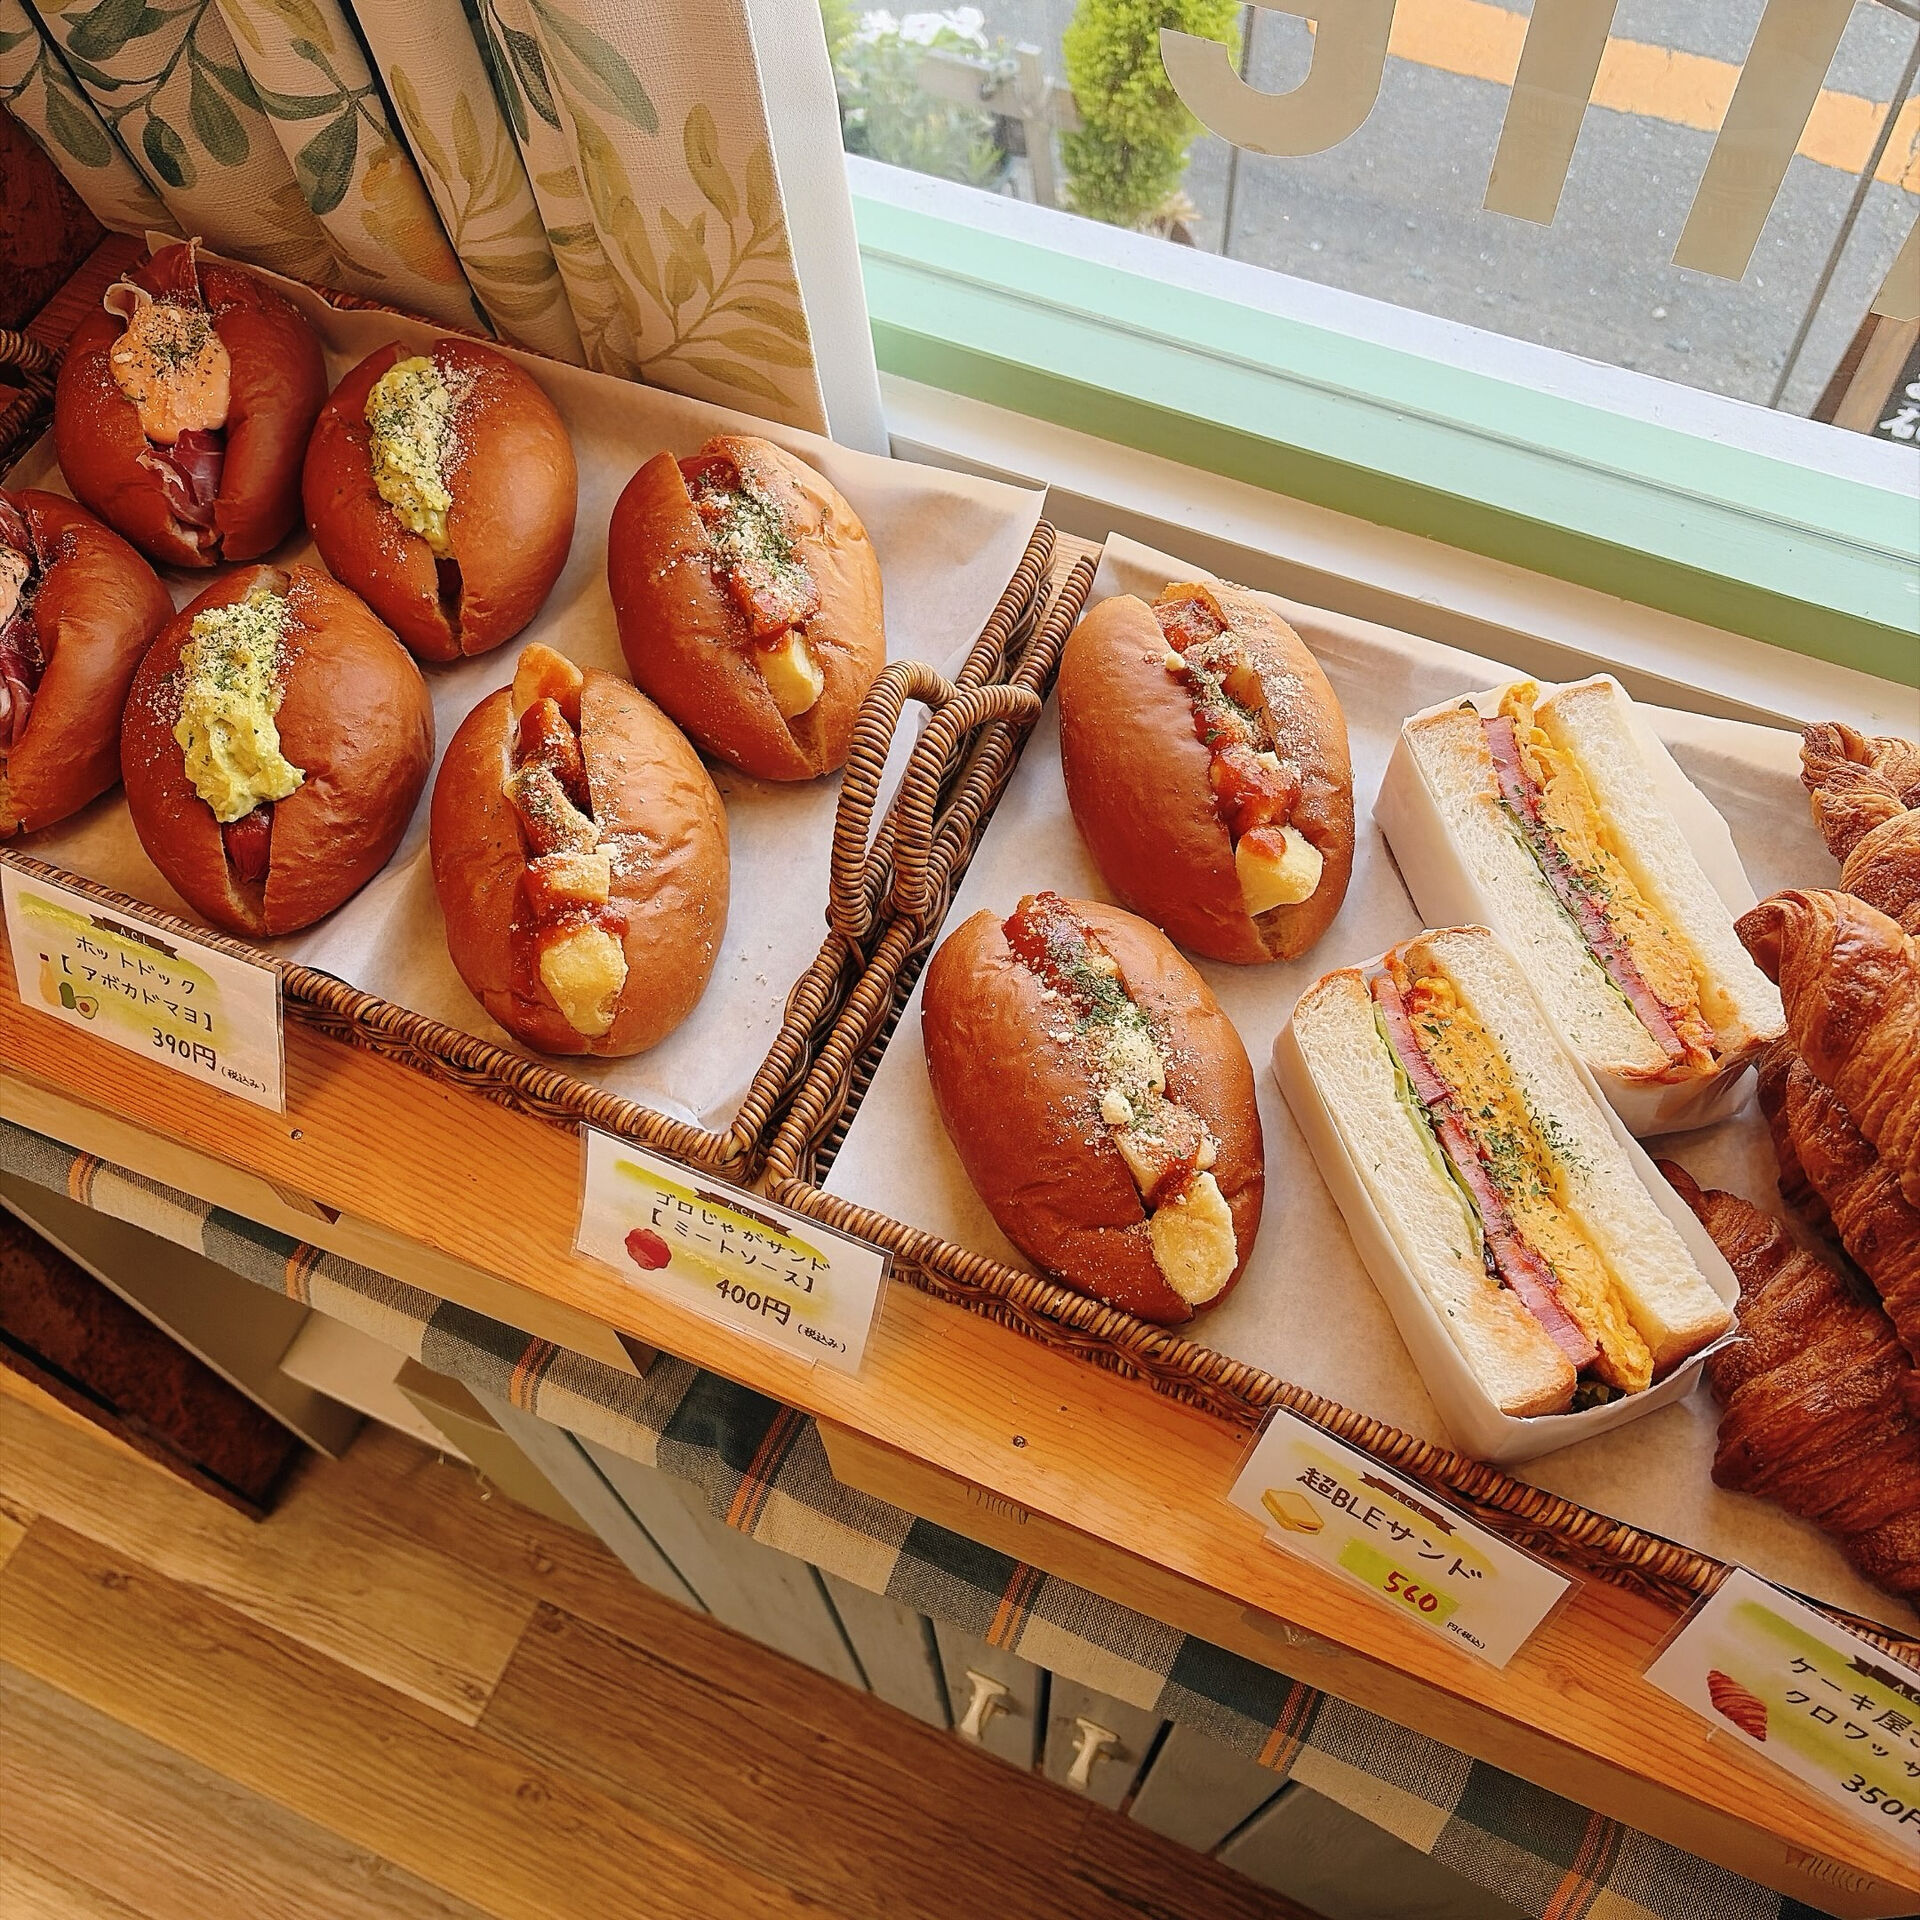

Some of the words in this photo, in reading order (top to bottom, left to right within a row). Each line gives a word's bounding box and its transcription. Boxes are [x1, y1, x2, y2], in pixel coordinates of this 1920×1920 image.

[60, 954, 213, 1032] 【アボカドマヨ】
[76, 936, 195, 995] ホットドック
[152, 1027, 217, 1071] 390円
[221, 1066, 267, 1093] (税込み)
[650, 1208, 813, 1293] 【ミートソース】
[655, 1191, 831, 1272] ゴロじゃがサンド
[716, 1278, 792, 1325] 400円
[797, 1323, 846, 1353] (税込み)
[1295, 1466, 1482, 1580] 超BLEサンド
[1382, 1570, 1439, 1613] 560
